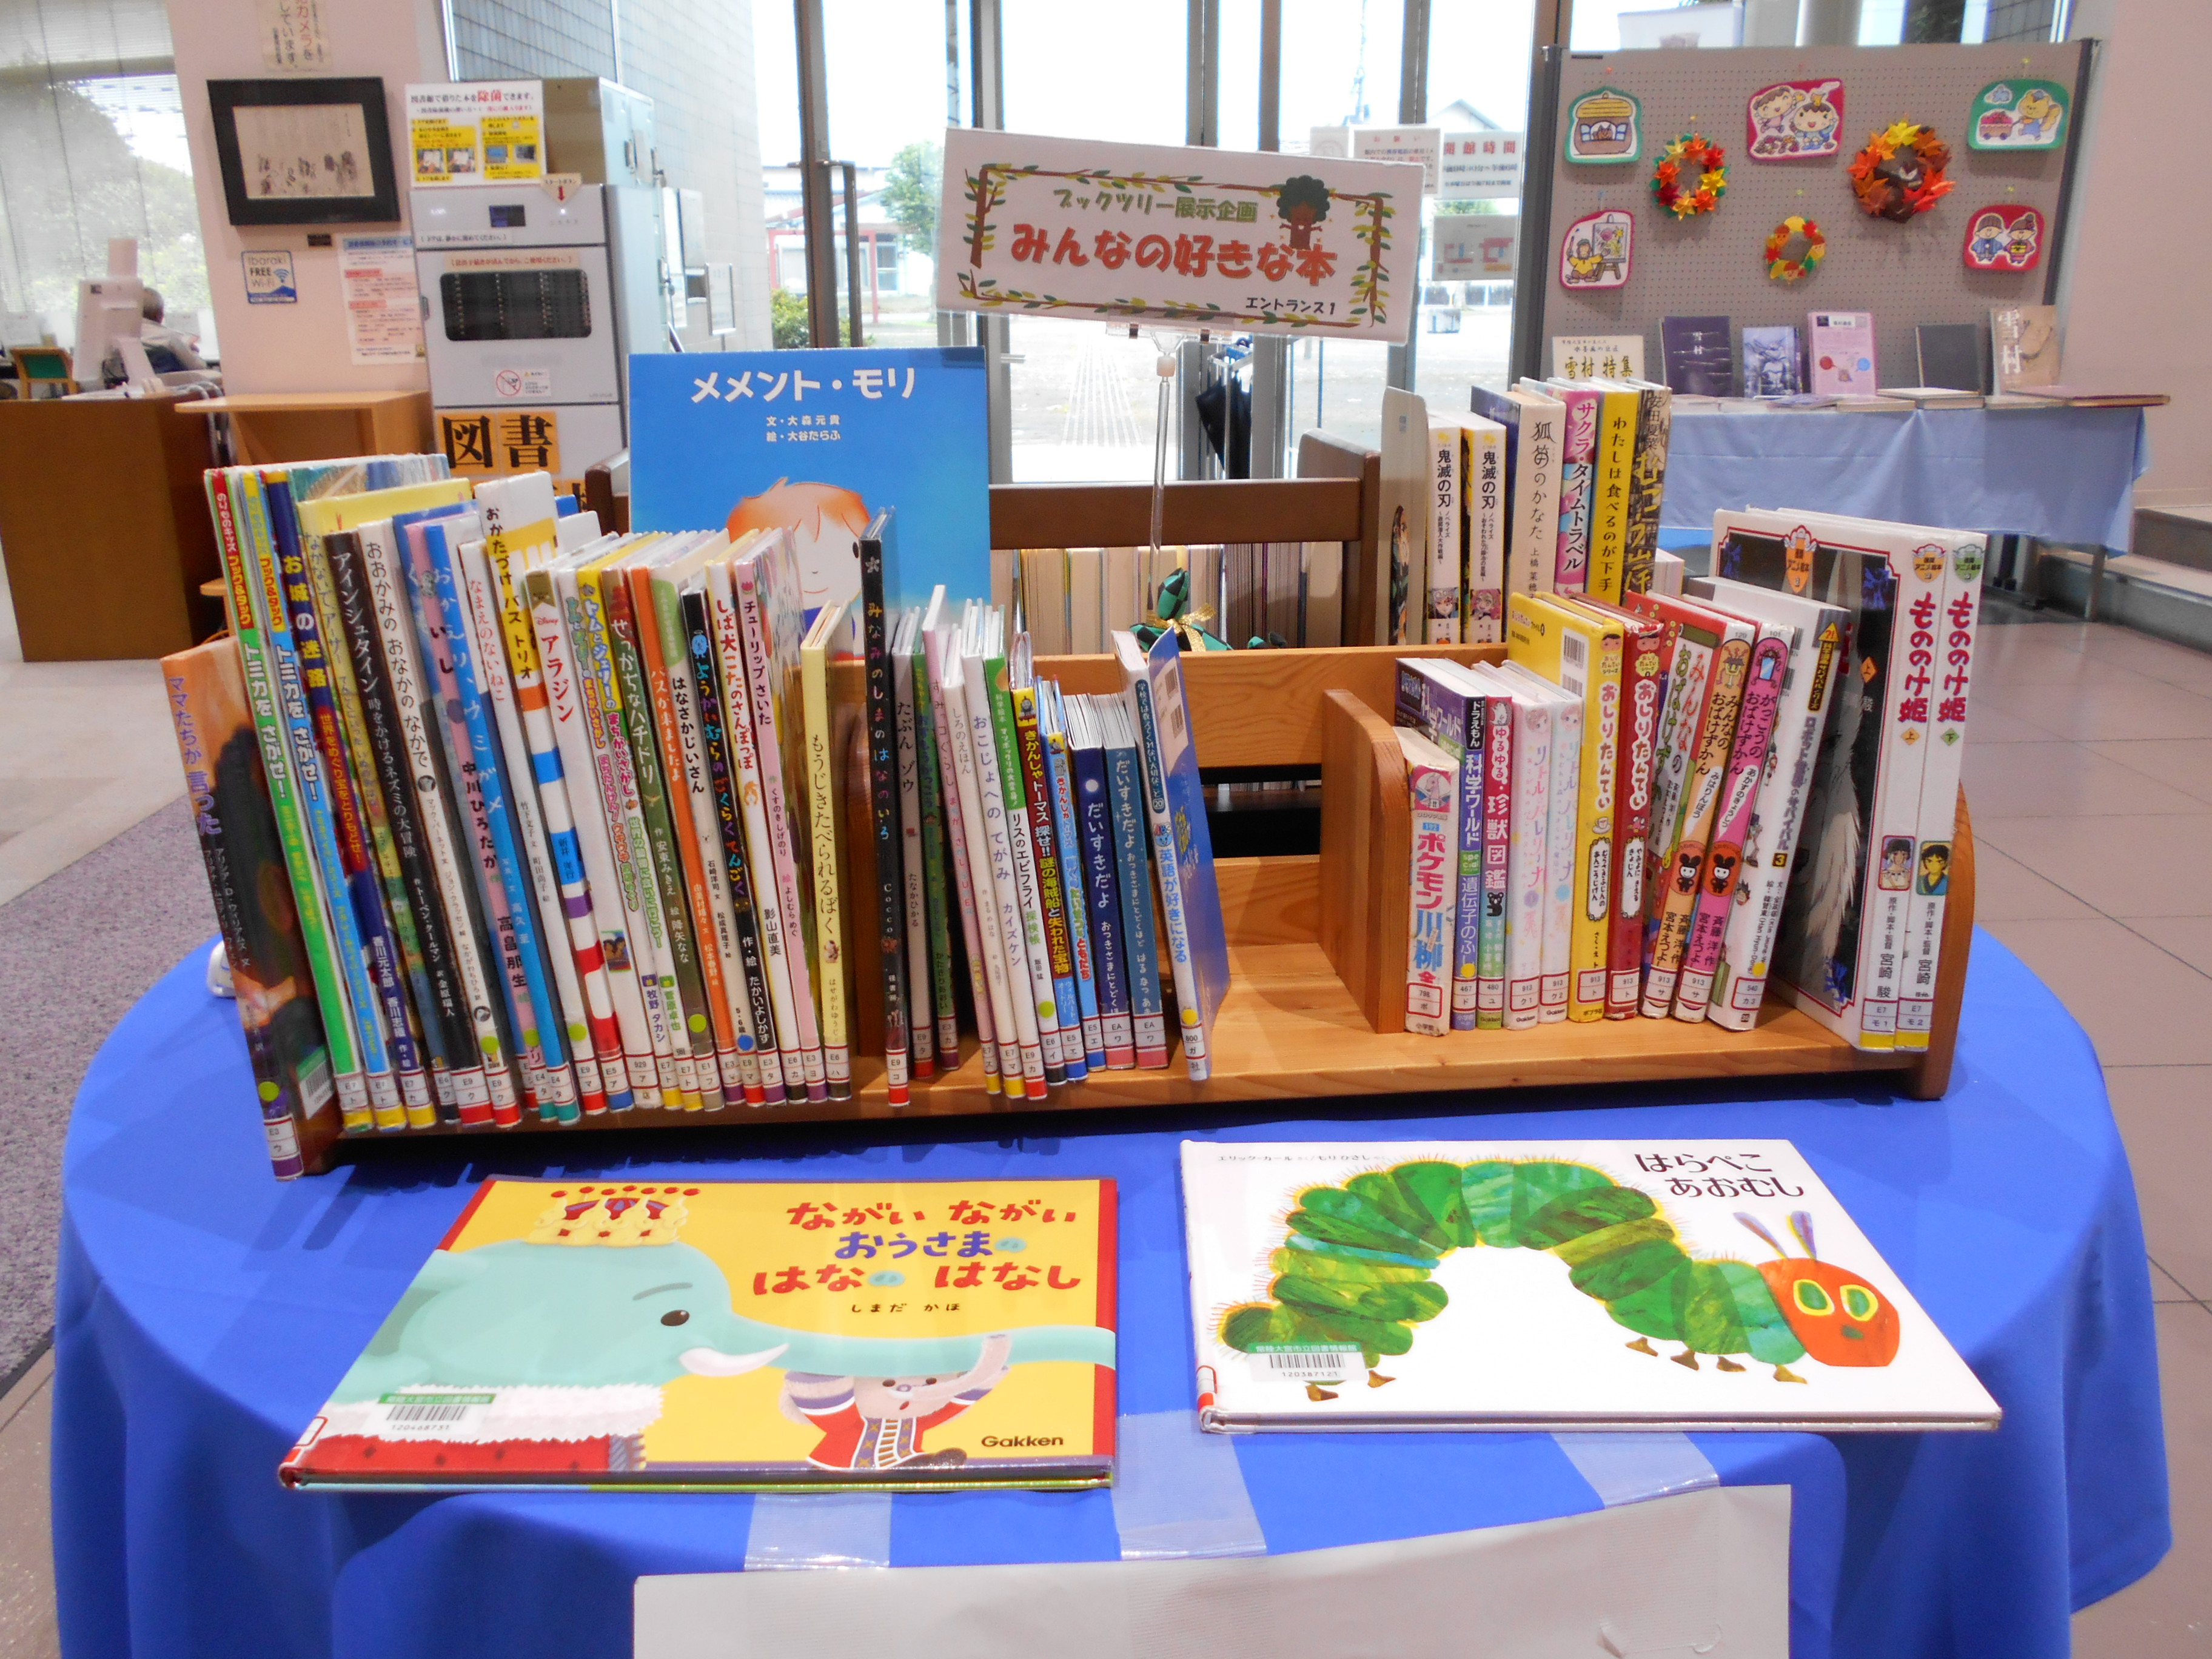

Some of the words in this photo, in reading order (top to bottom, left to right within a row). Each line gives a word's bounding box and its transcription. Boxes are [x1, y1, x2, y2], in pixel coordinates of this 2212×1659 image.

[1053, 189, 1258, 223] ブックツリー展示企画
[249, 255, 286, 265] Ibaraki
[249, 267, 271, 276] FREE
[252, 278, 275, 287] Wi-Fi
[1011, 223, 1337, 286] みんなの好きな本
[691, 367, 915, 403] メメント・モリ
[1564, 355, 1594, 379] 雪村
[1602, 356, 1633, 378] 特集
[442, 415, 552, 468] 図書
[1437, 449, 1452, 508] 鬼滅の刃
[1481, 451, 1496, 509] 鬼滅の刃
[1530, 421, 1557, 540] 狐笛のかなた
[1598, 417, 1627, 592] わたしは食べるのが下手
[486, 508, 514, 586] おかたづけ
[282, 555, 327, 688] お城の迷路
[332, 550, 379, 691] アインシュタイン
[469, 578, 506, 702] なまえのないねこ
[504, 597, 522, 625] バス
[244, 643, 272, 717] トミカを
[276, 645, 304, 719] トミカを
[366, 541, 398, 632] おおかみの
[386, 639, 415, 710] おなかの
[404, 715, 429, 768] なかで
[512, 638, 533, 680] トリオ
[541, 634, 574, 723] アラジン
[743, 600, 765, 680] チューリップ
[756, 685, 772, 726] さいた
[1897, 591, 1937, 723] もののけ姫
[1937, 591, 1974, 723] もののけ姫
[582, 676, 606, 749] まちがいさがし
[611, 618, 655, 785] せっかちなハチドリ
[672, 675, 705, 794] はなさかじいさん
[897, 701, 913, 751] たぶん
[934, 679, 955, 787] すみっコぐらし
[1470, 701, 1481, 748] ドラえもん
[1695, 692, 1727, 776] おばけずかん
[1717, 695, 1741, 751] みんなの
[1729, 691, 1760, 776] おばけずかん
[1749, 692, 1777, 759] がっこうの
[606, 711, 635, 797] まちがいさがし
[900, 759, 916, 793] ゾウ
[953, 708, 971, 775] しろのえほん
[1597, 683, 1618, 809] おしりたんてい
[1632, 682, 1655, 808] おしりたんてい
[367, 697, 417, 857] 時をかけるネズミの大冒険
[973, 716, 1002, 819] おこじょへの
[990, 832, 1011, 880] てがみ
[1114, 759, 1136, 849] だいすきだよ
[1464, 754, 1483, 848] 科学ワールド
[461, 761, 497, 870] 中川ひろたか
[812, 734, 839, 935] もうじきたべられるぼく
[1485, 793, 1509, 890] 珍獣図鑑
[1011, 813, 1033, 909] リスのエビフライ
[1087, 802, 1111, 909] だいすきだよ
[1416, 832, 1447, 910] ポケモン
[763, 908, 782, 956] 影山直美
[883, 883, 893, 934] Cocco
[1002, 903, 1022, 967] カイズケン
[1159, 849, 1187, 964] 英語が好きになる
[497, 915, 526, 987] 高畠那生
[742, 936, 757, 968] 作・絵
[1657, 976, 1671, 984] 913
[1692, 977, 1705, 986] 913
[1878, 953, 1895, 979] 宮崎
[749, 975, 769, 1044] たかいよしかず
[463, 1078, 474, 1086] E9
[1634, 1153, 1773, 1173] はらぺこ
[1664, 1176, 1805, 1198] あおむし
[786, 1201, 926, 1230] ながい
[948, 1198, 1077, 1225] ながい
[834, 1230, 993, 1259] おうさま
[752, 1262, 866, 1296] はな
[934, 1261, 1081, 1292] はなし
[850, 1302, 908, 1313] しまだ
[923, 1302, 961, 1313] かほ
[981, 1434, 1065, 1450] Gakken
